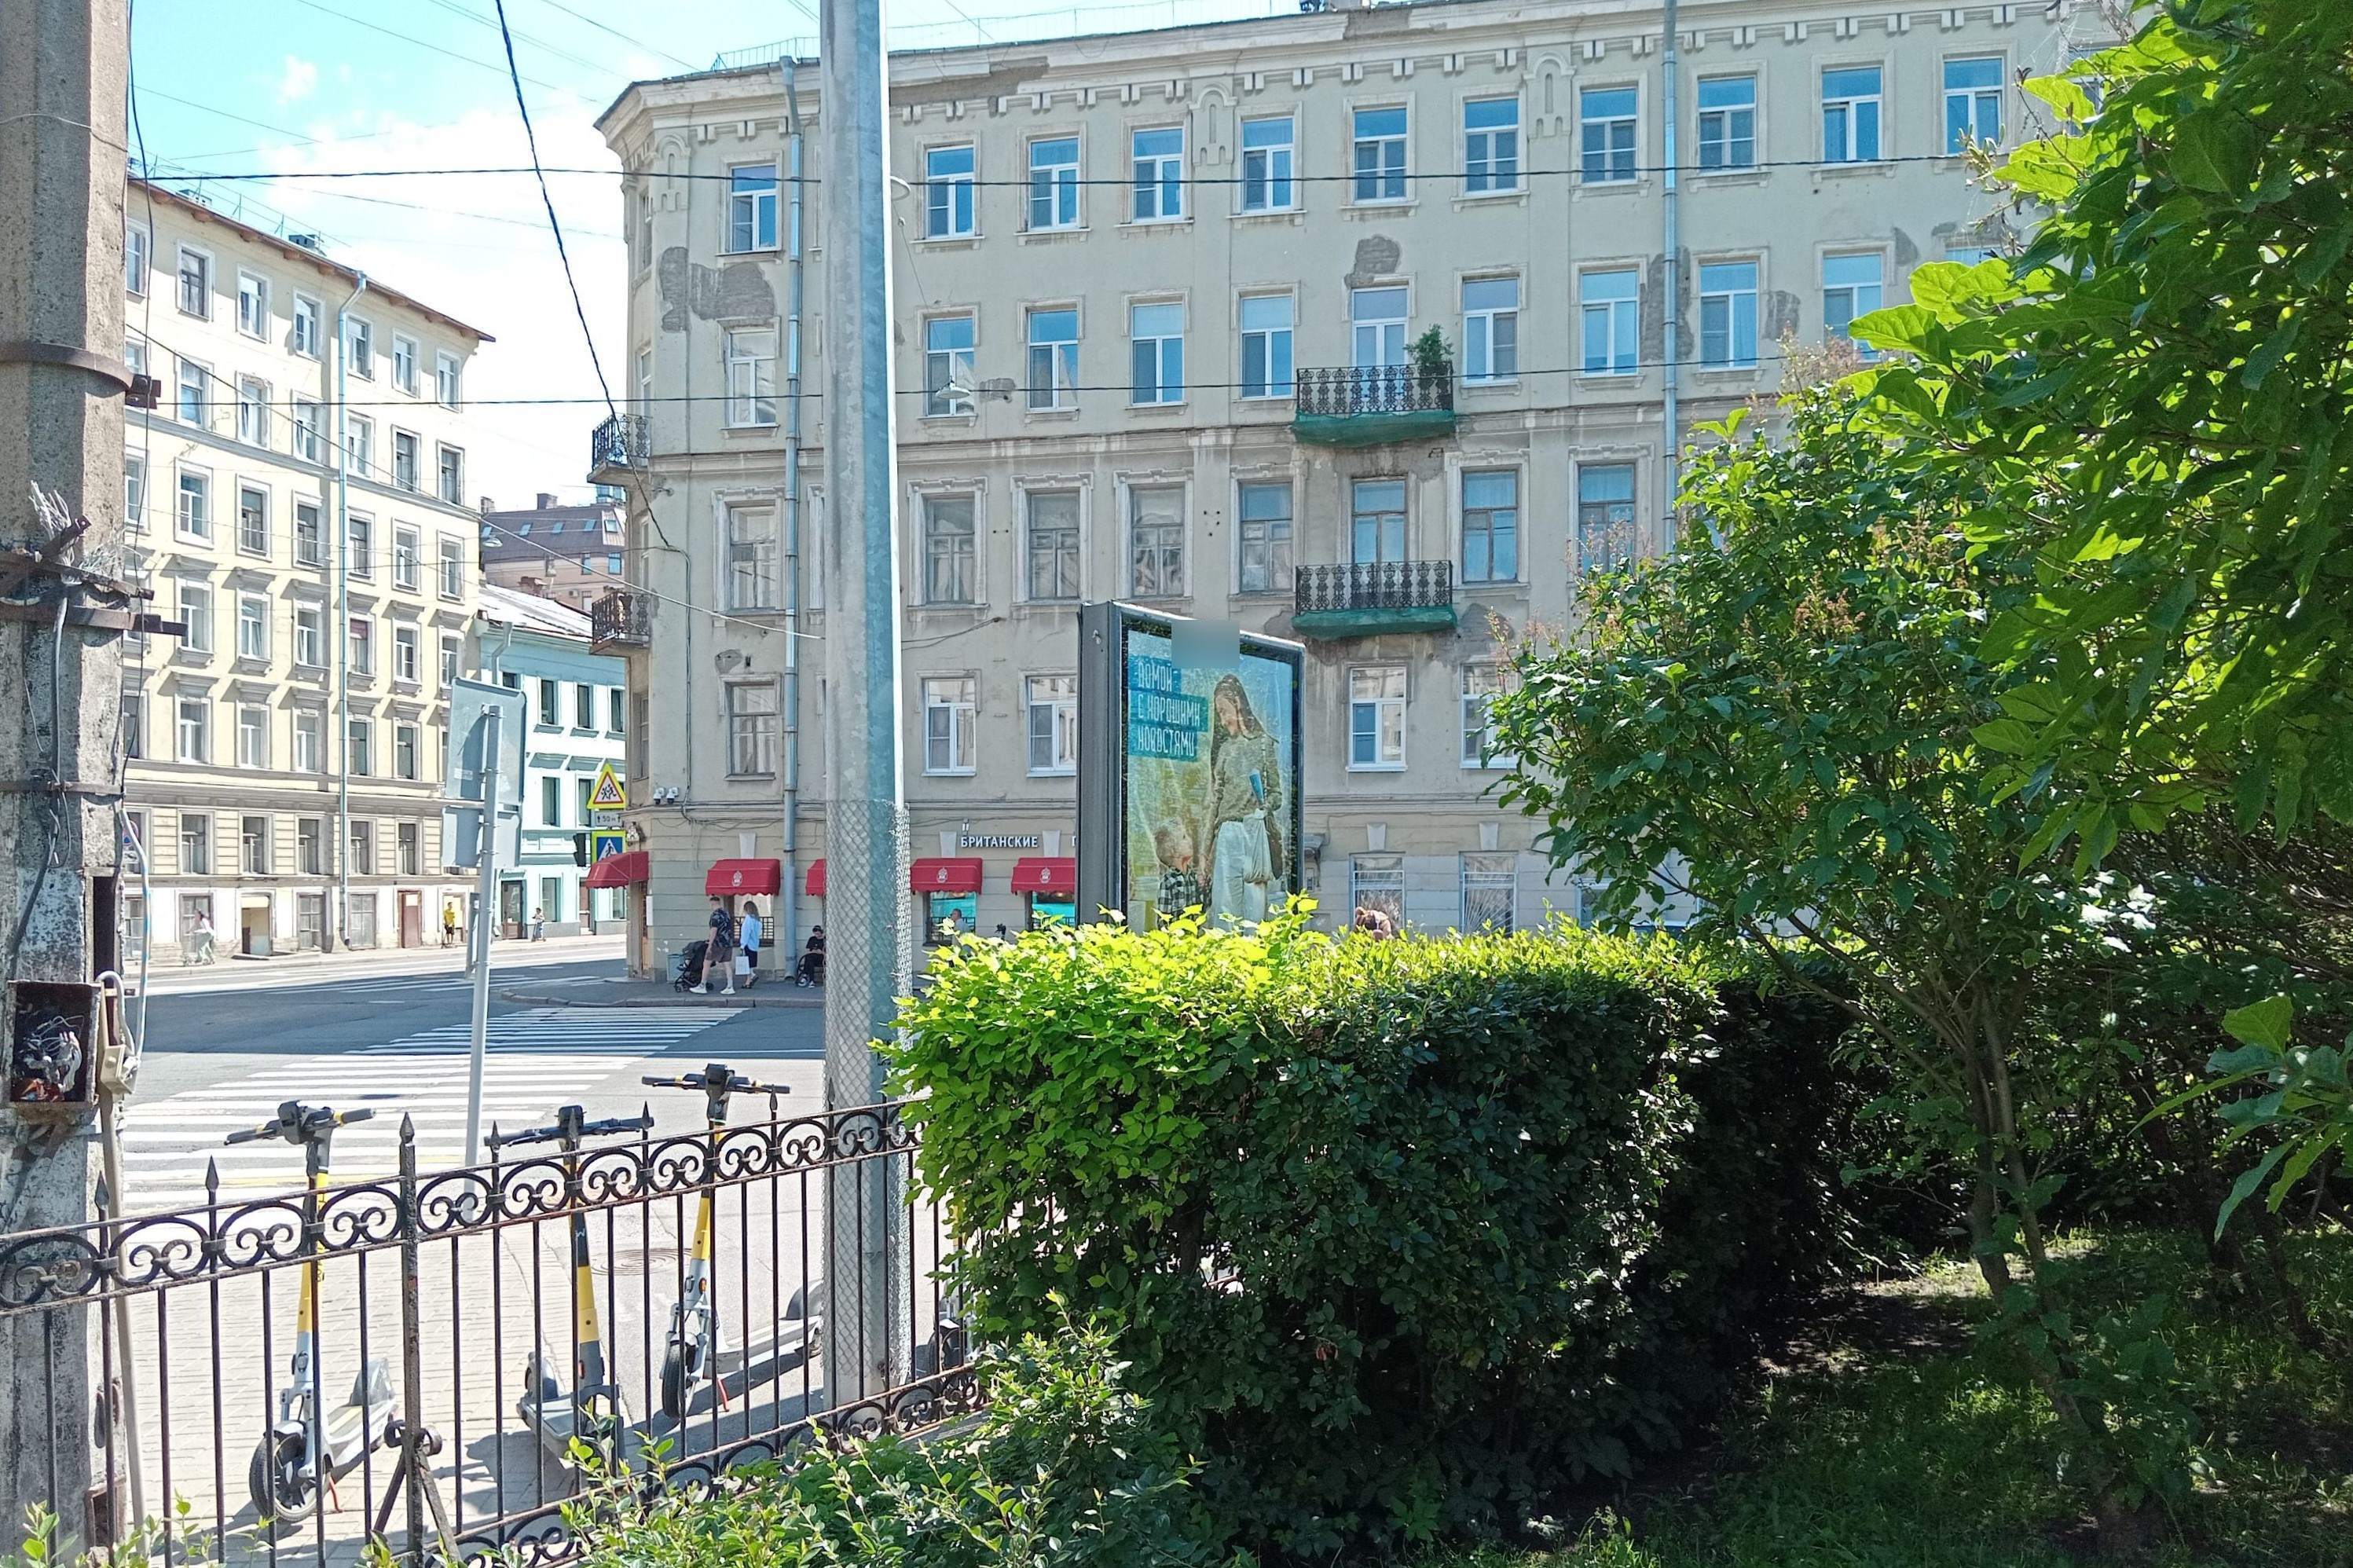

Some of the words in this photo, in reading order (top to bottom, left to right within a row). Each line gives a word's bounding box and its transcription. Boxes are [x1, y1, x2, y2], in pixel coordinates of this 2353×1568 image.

[1138, 659, 1172, 692] ДОМОЙ
[1138, 694, 1144, 719] С
[1147, 694, 1200, 727] ХОРОШИМИ
[1138, 724, 1195, 757] НОВОСТЯМИ
[960, 835, 1039, 848] БРИТАНСКИЕ
